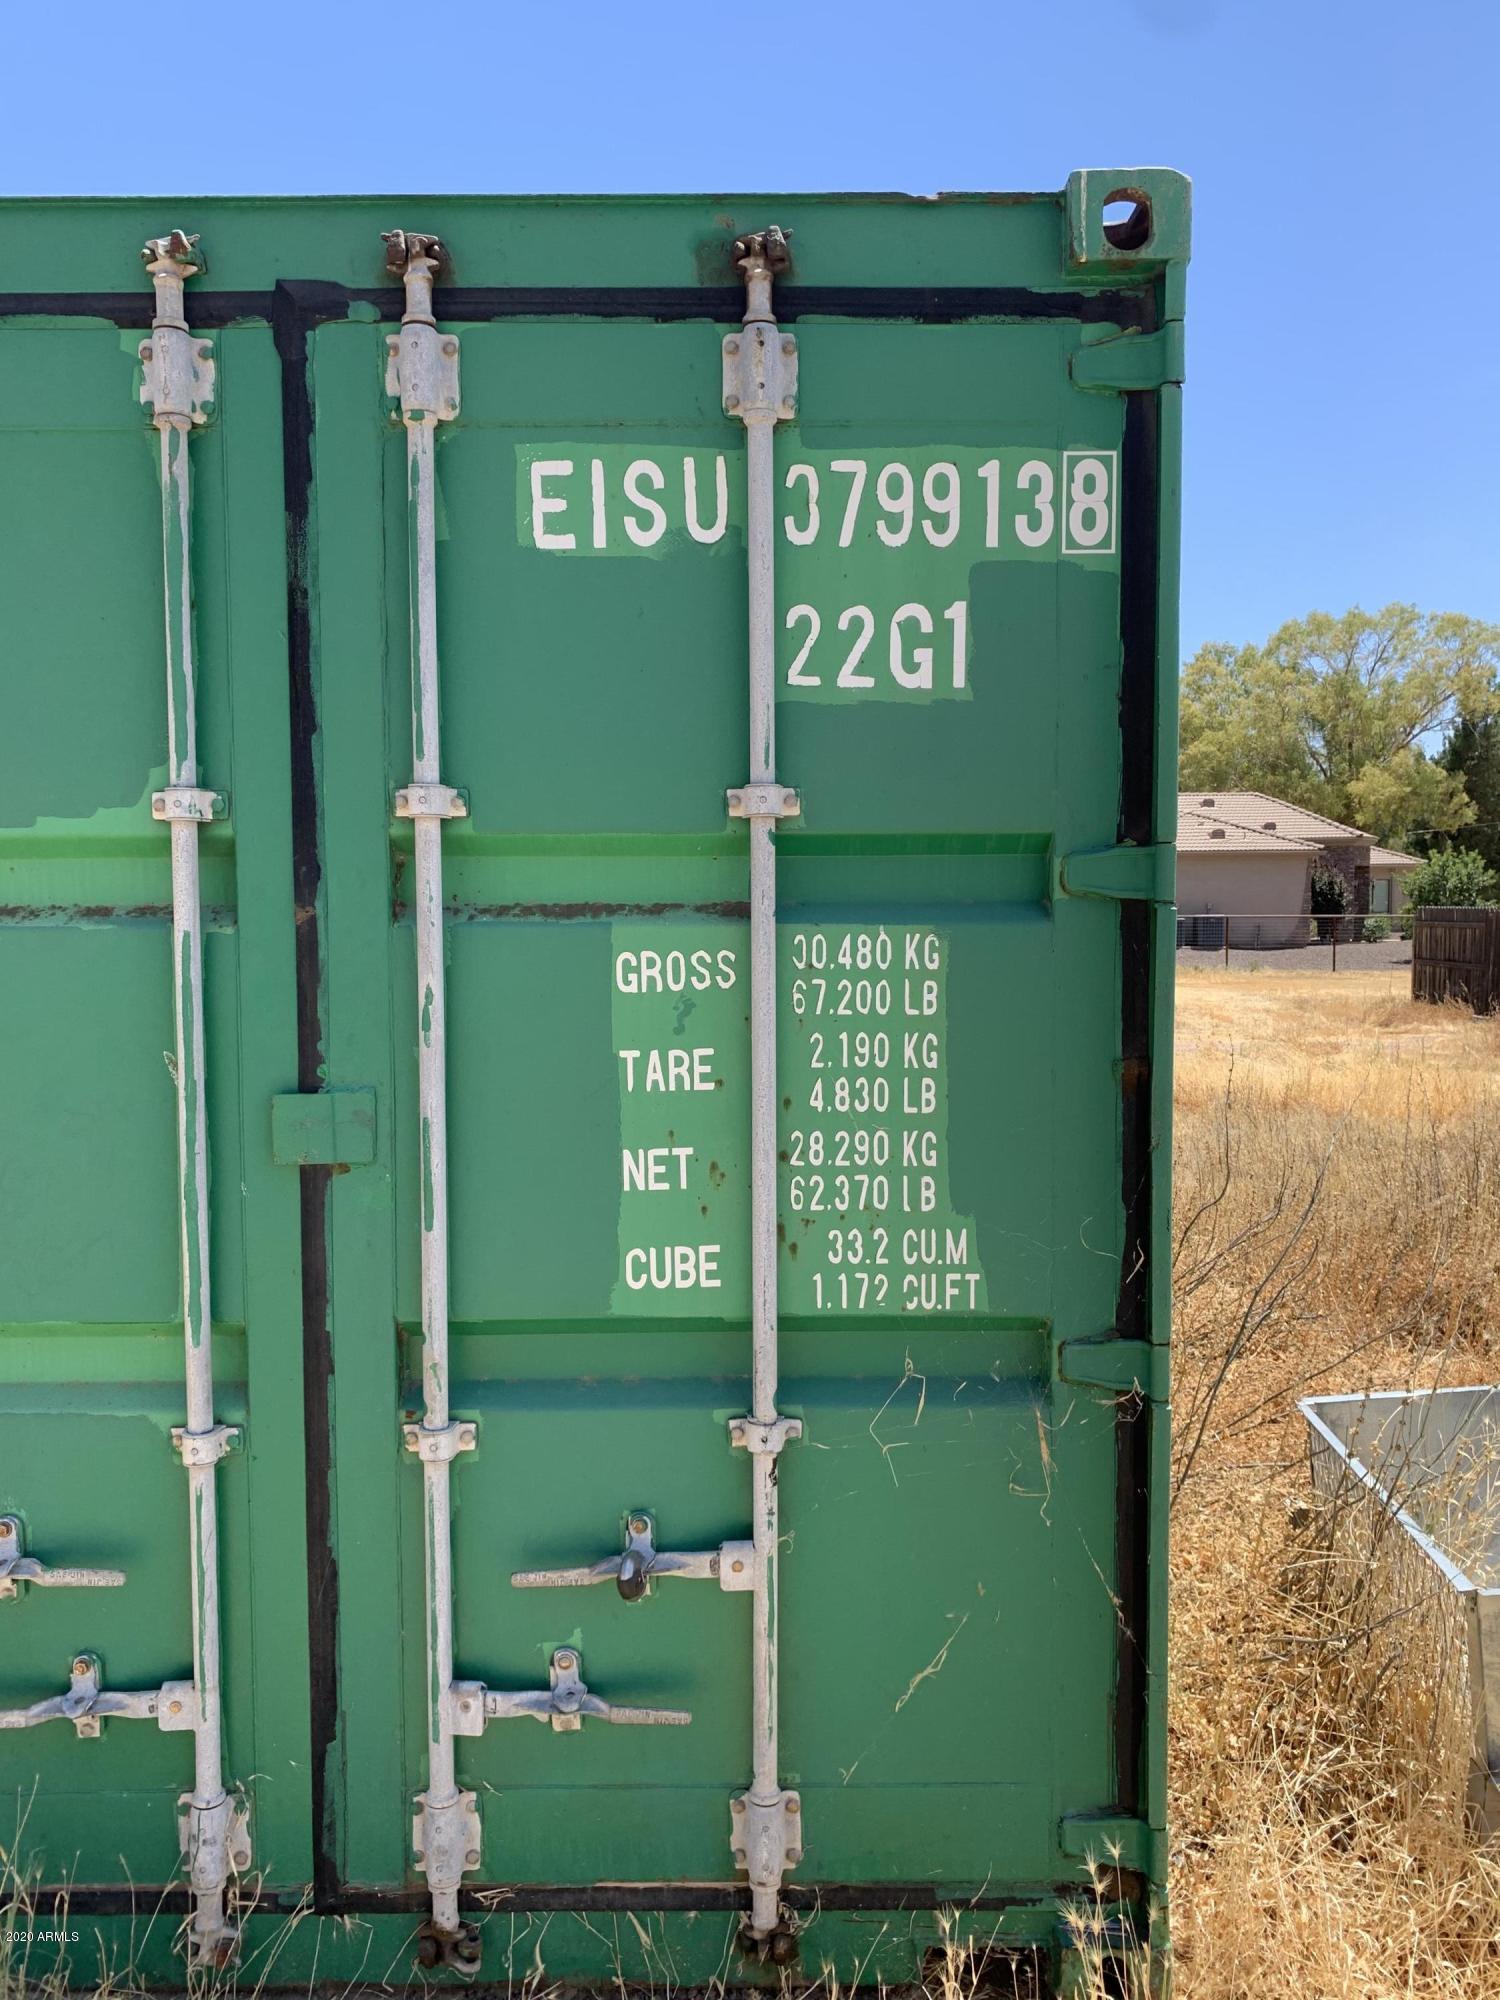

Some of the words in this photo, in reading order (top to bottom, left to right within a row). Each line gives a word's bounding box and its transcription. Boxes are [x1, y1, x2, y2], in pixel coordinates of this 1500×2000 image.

[531, 455, 728, 550] EISU
[785, 600, 967, 689] 22G1
[615, 949, 736, 994] GROSS
[904, 933, 940, 970] KG
[904, 978, 938, 1016] LB
[618, 1047, 716, 1093] TARE
[903, 1031, 938, 1069] KG
[903, 1076, 936, 1114] LB
[622, 1146, 694, 1192] NET
[902, 1130, 937, 1167] KG
[827, 1227, 889, 1265] 33.2
[902, 1228, 967, 1265] CU.M
[625, 1244, 722, 1290] CUBE
